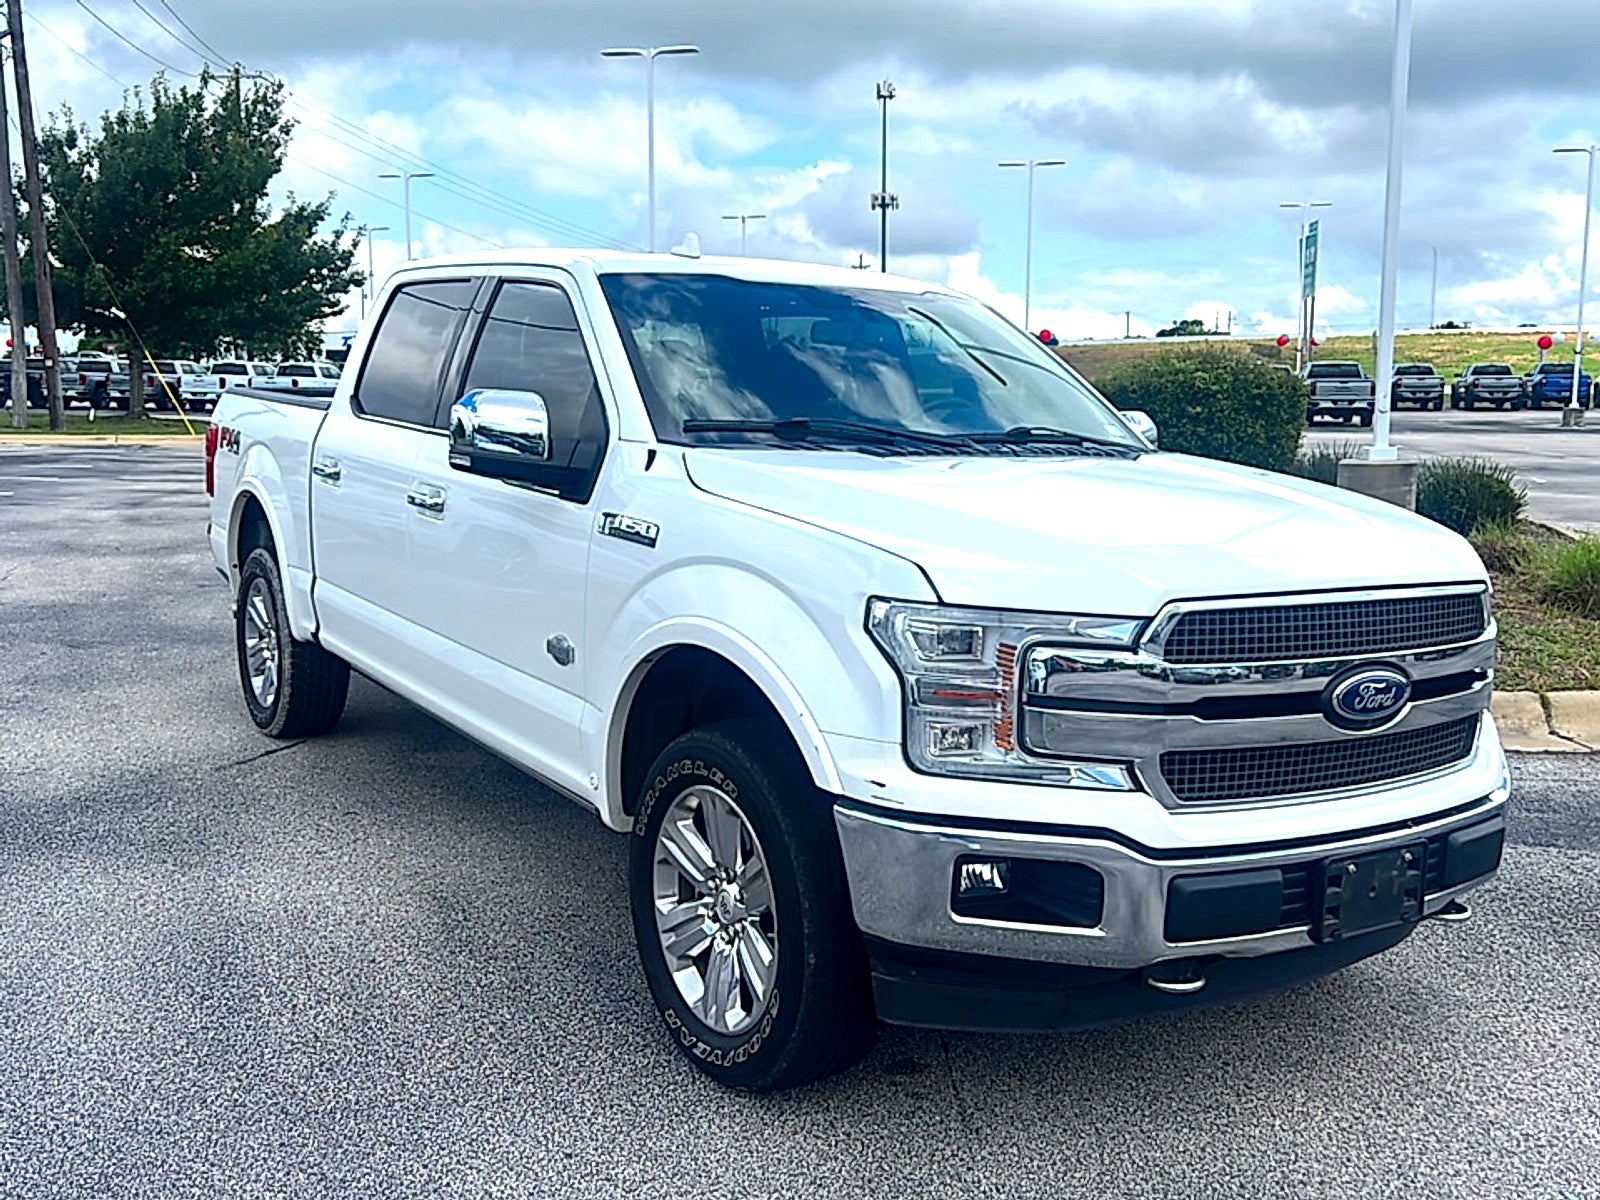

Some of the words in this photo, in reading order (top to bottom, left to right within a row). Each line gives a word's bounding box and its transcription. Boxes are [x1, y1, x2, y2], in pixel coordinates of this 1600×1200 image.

[1354, 681, 1397, 711] Ford
[635, 759, 739, 837] WRANGLER
[664, 987, 780, 1067] GOODYEAR
